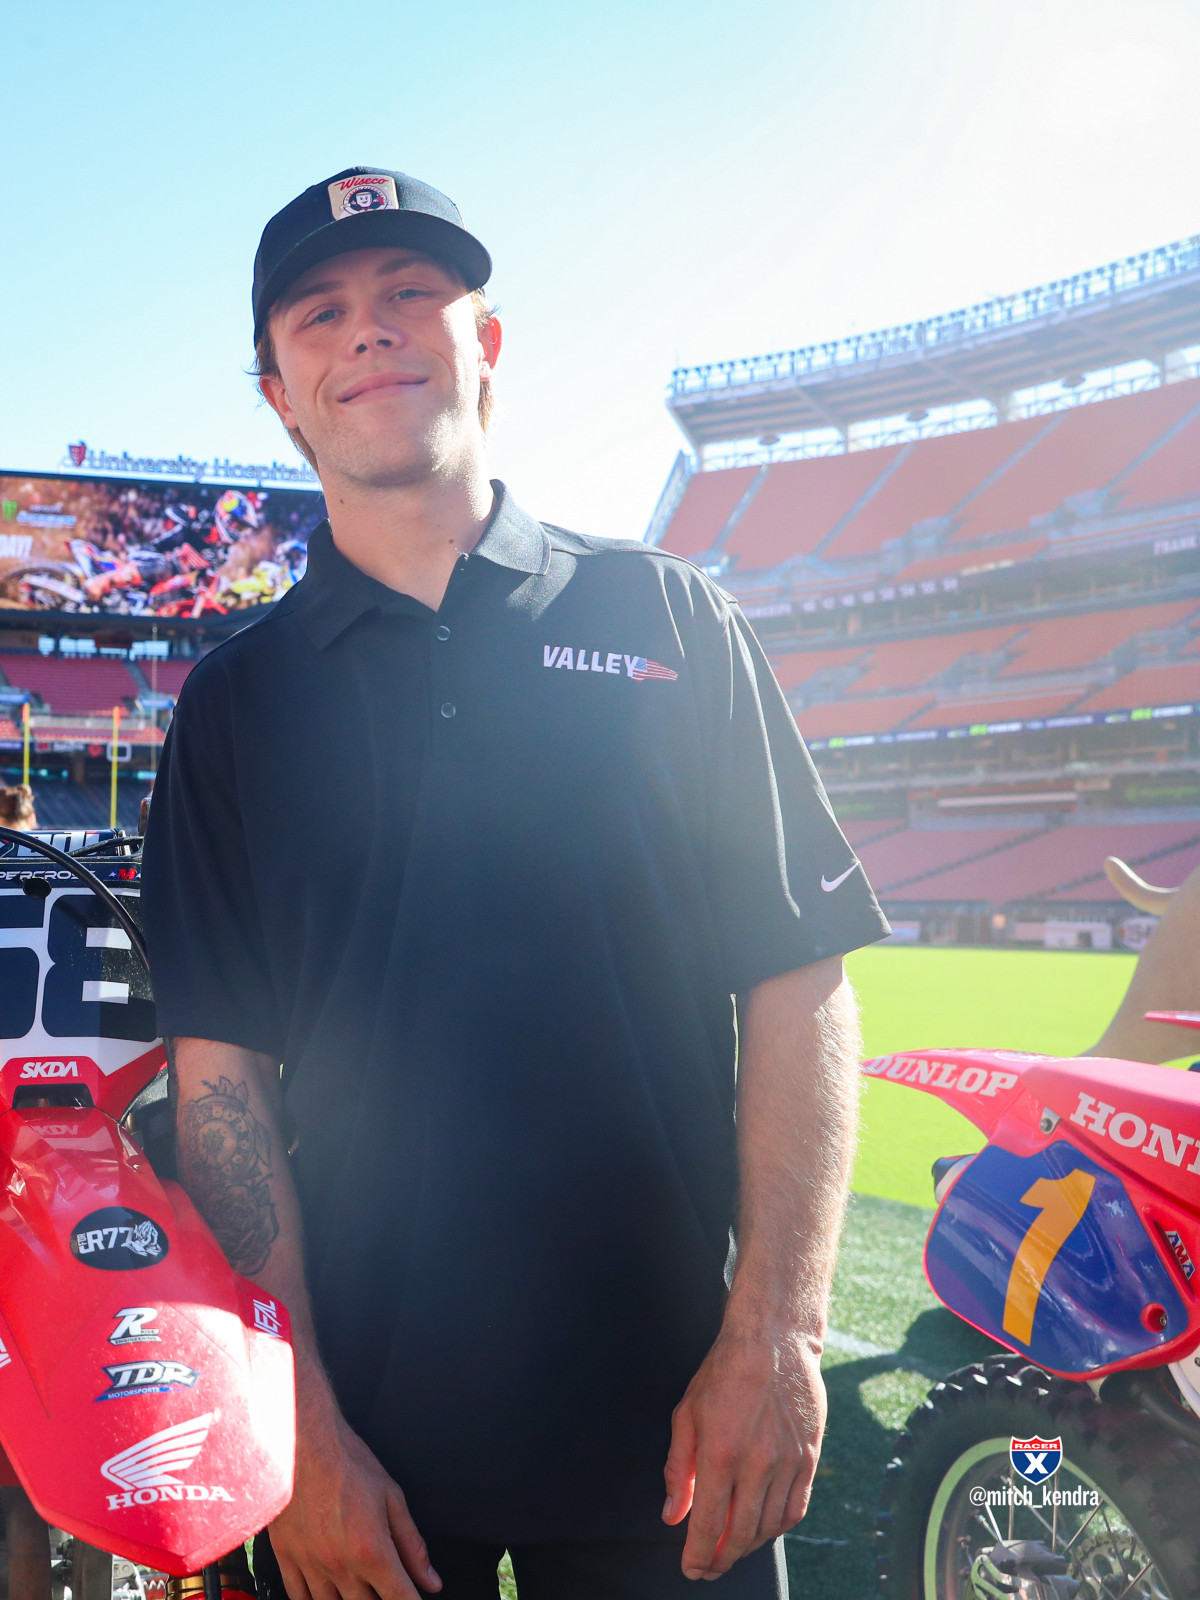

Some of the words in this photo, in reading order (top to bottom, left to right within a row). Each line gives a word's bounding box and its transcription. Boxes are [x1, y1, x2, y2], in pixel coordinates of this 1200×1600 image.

[334, 177, 389, 191] Wiseco
[543, 645, 640, 678] VALLEY
[19, 1061, 80, 1079] SKDA
[866, 1056, 1018, 1097] DUNLOP
[1002, 1168, 1097, 1347] 1
[1167, 1232, 1195, 1279] AMA
[108, 1306, 159, 1339] R
[104, 1360, 197, 1388] TDR
[107, 1386, 161, 1399] MOTORSPORTS
[106, 1485, 236, 1511] HONDA
